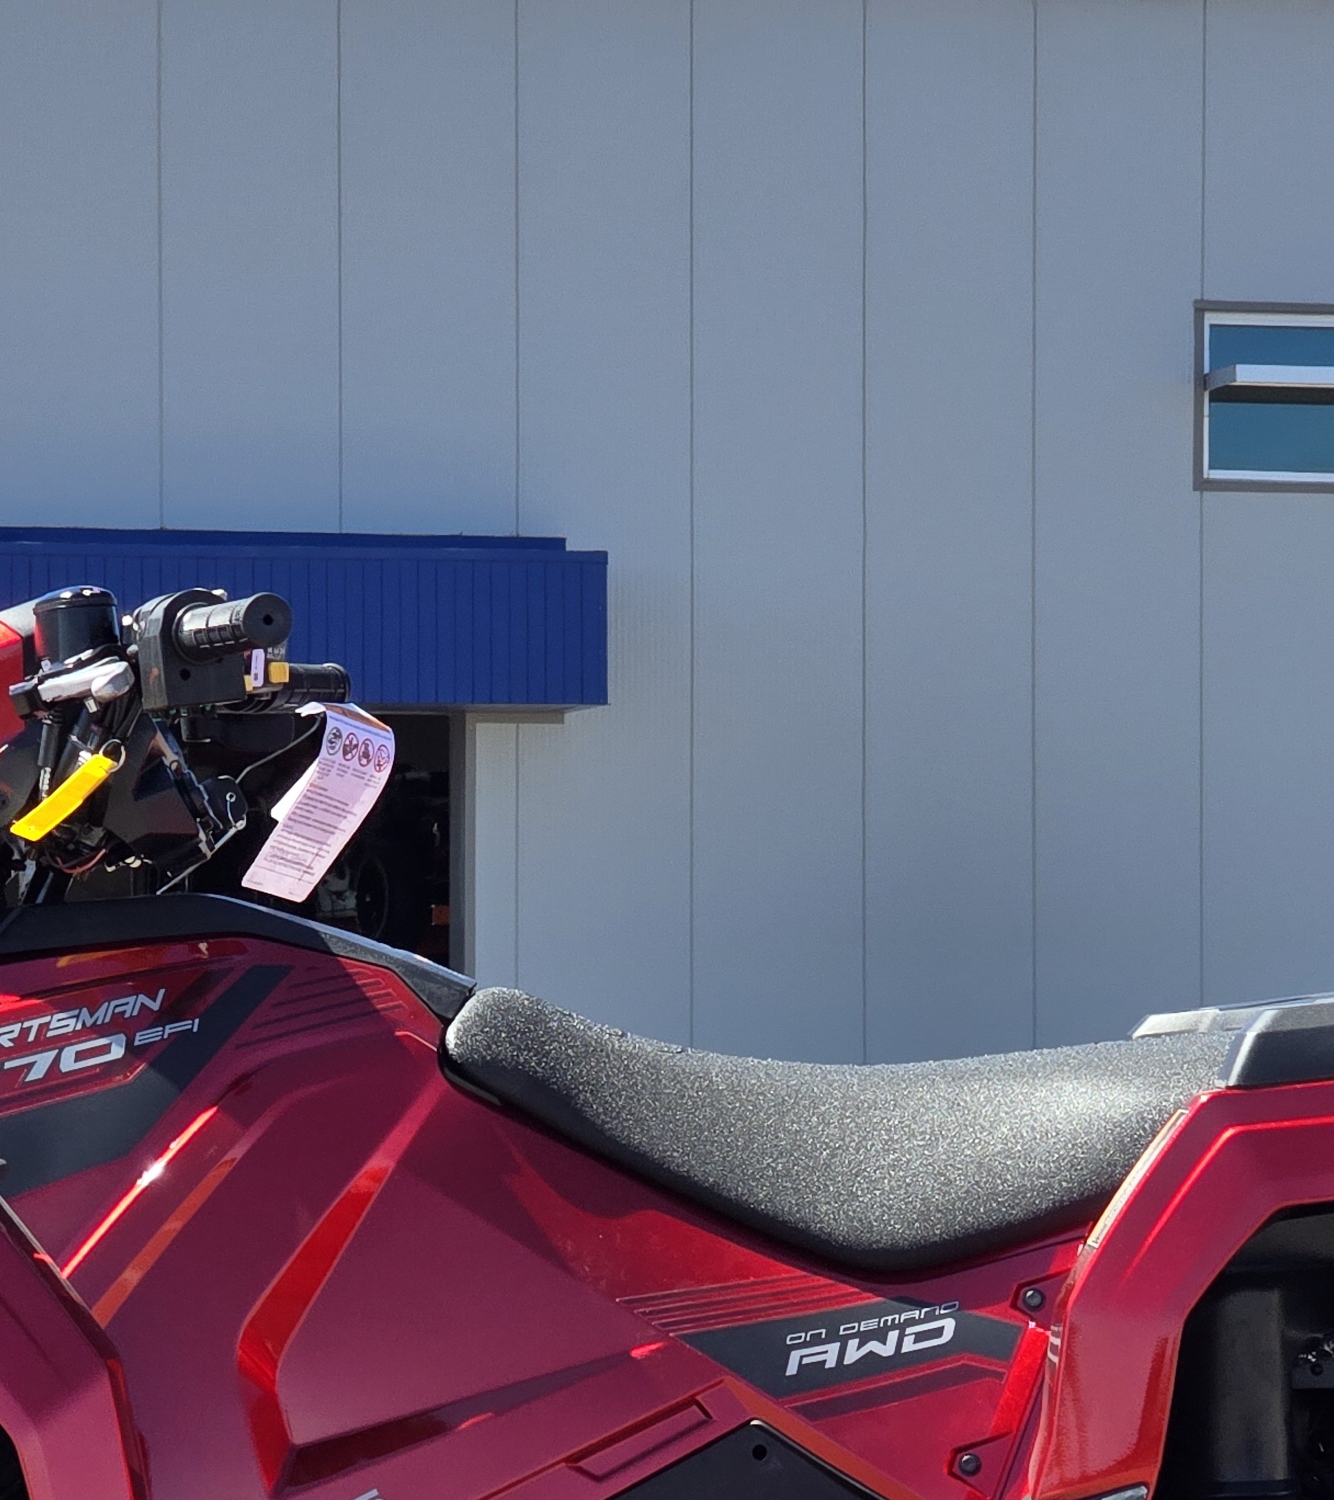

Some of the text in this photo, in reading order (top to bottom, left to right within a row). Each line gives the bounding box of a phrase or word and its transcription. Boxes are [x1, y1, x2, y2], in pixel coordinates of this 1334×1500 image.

[133, 1019, 200, 1047] EFI
[785, 1300, 960, 1345] ON DEMAND
[784, 1317, 957, 1376] AWD
